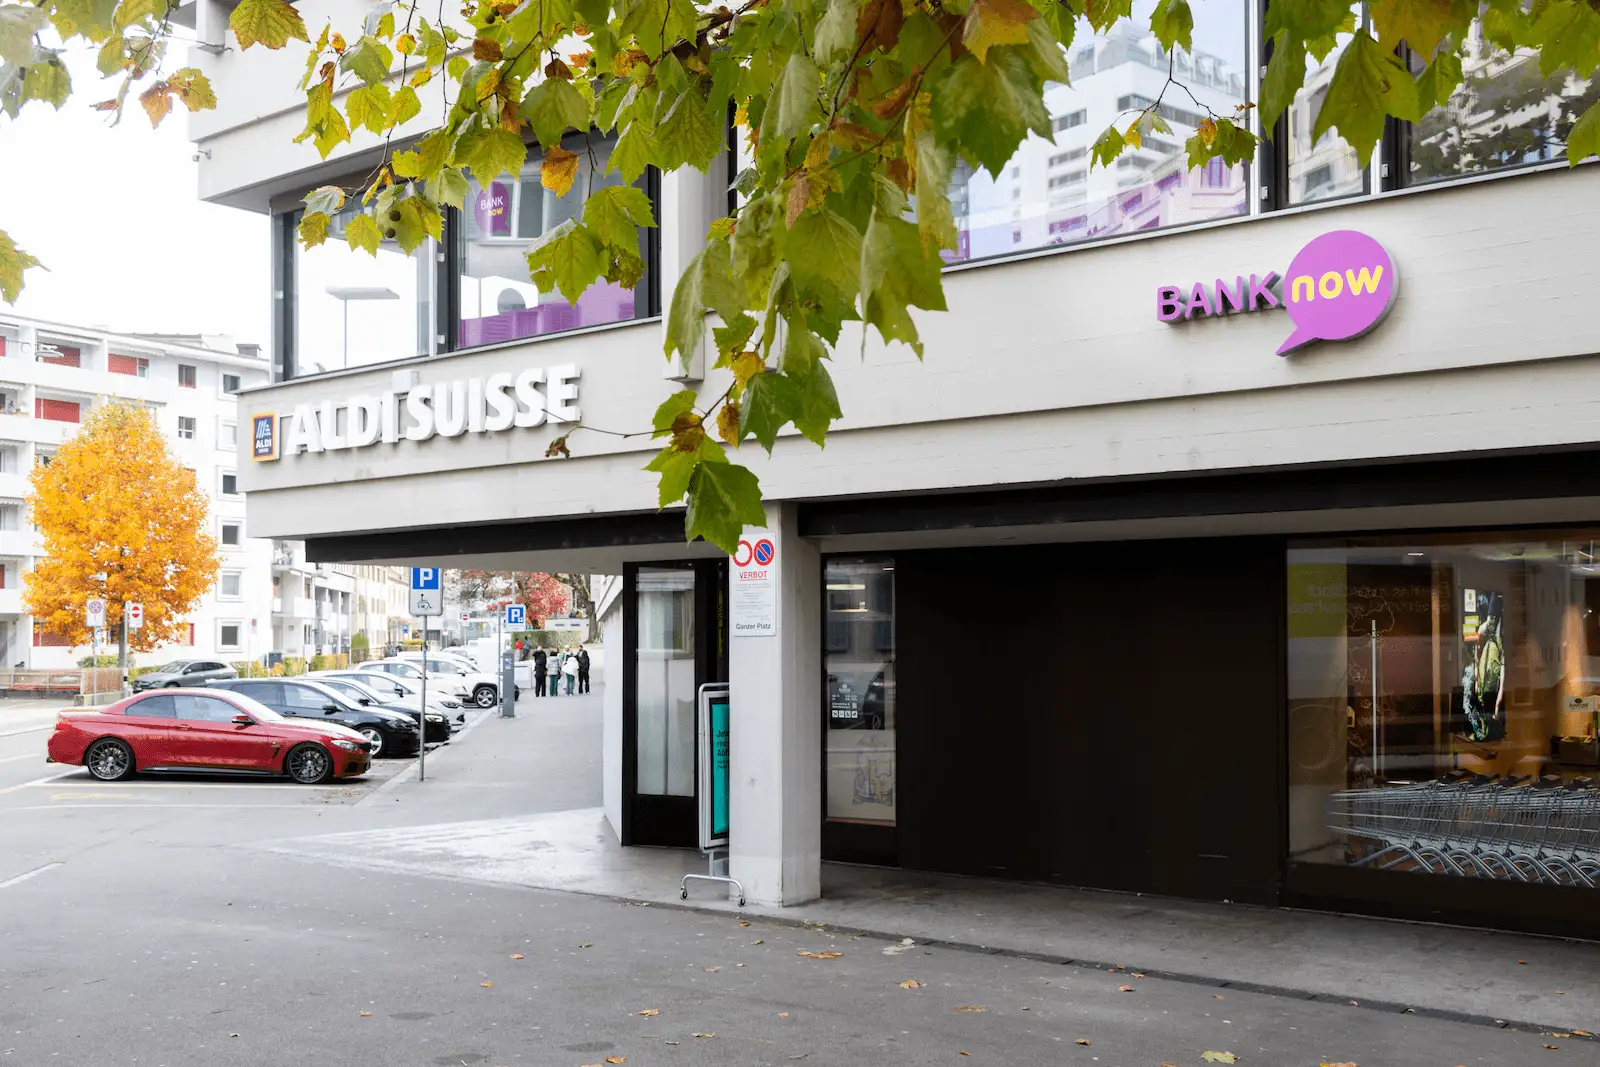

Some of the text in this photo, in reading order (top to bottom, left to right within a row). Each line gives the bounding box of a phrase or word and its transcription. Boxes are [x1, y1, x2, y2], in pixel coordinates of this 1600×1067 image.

[480, 195, 504, 210] BANK
[1157, 264, 1385, 323] BANK now
[285, 364, 582, 455] ALDI SUISSE
[255, 438, 272, 449] ALDI
[419, 567, 434, 588] P
[739, 570, 768, 580] VERBOT
[510, 608, 521, 623] P
[735, 622, 771, 631] Ganzer Platz
